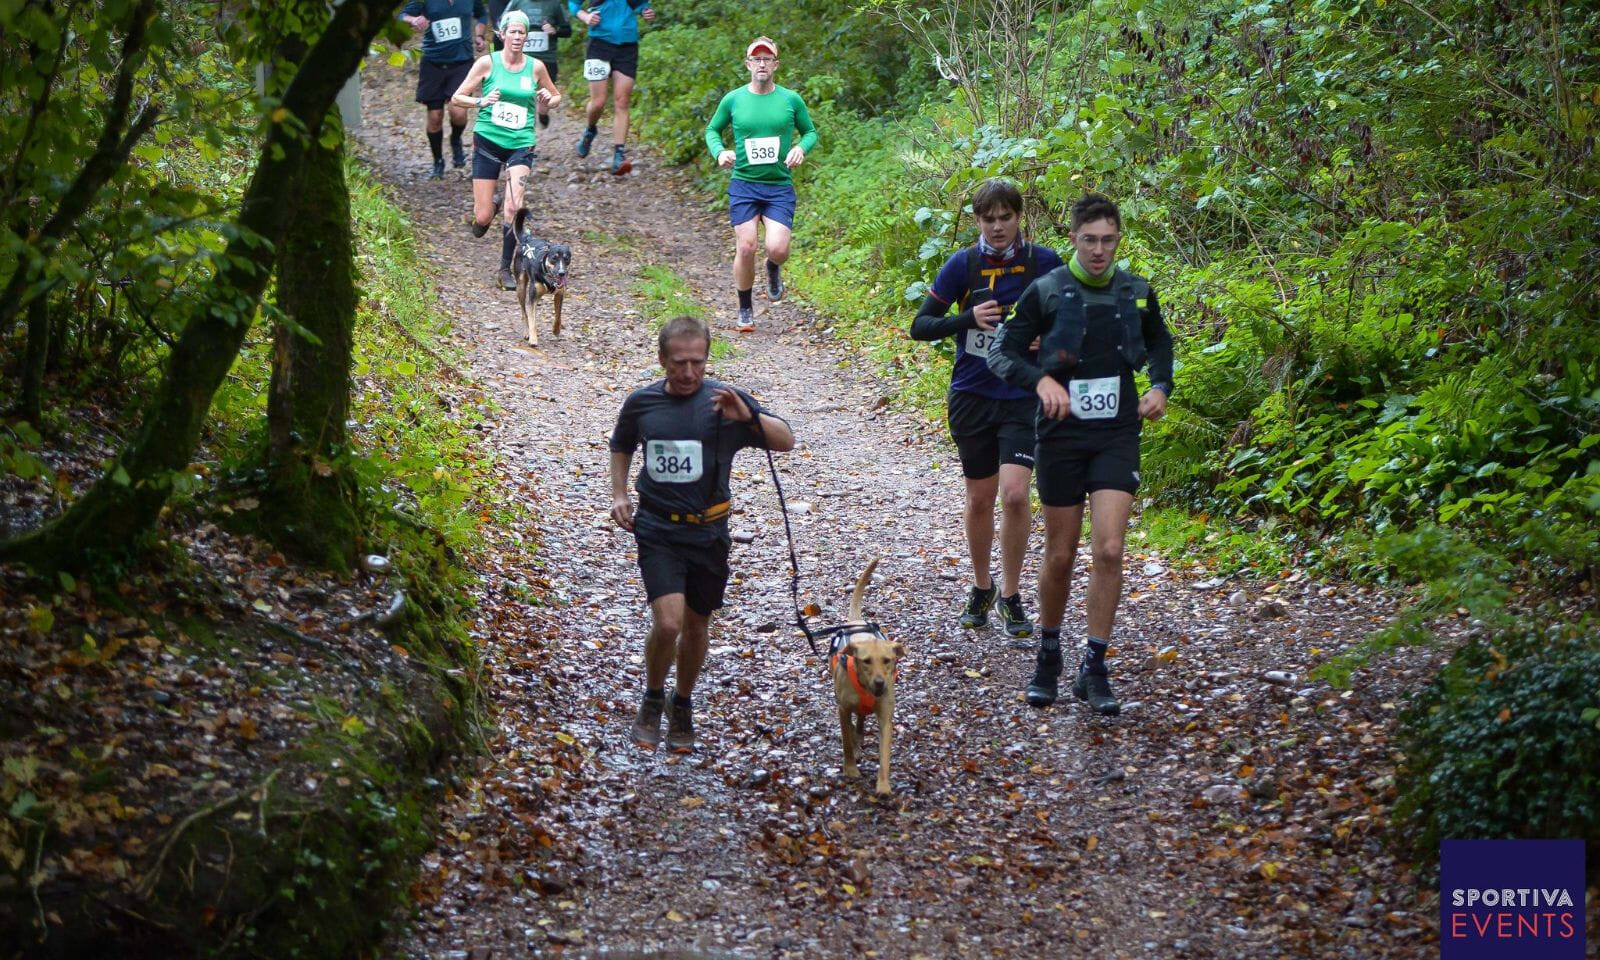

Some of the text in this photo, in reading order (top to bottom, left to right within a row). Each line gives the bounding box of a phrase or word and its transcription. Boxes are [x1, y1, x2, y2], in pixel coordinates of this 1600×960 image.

[438, 25, 458, 37] 519
[588, 66, 606, 76] 496
[498, 112, 519, 124] 421
[752, 147, 775, 159] 538
[974, 333, 996, 351] 37
[1080, 393, 1117, 412] 330
[656, 456, 692, 473] 384
